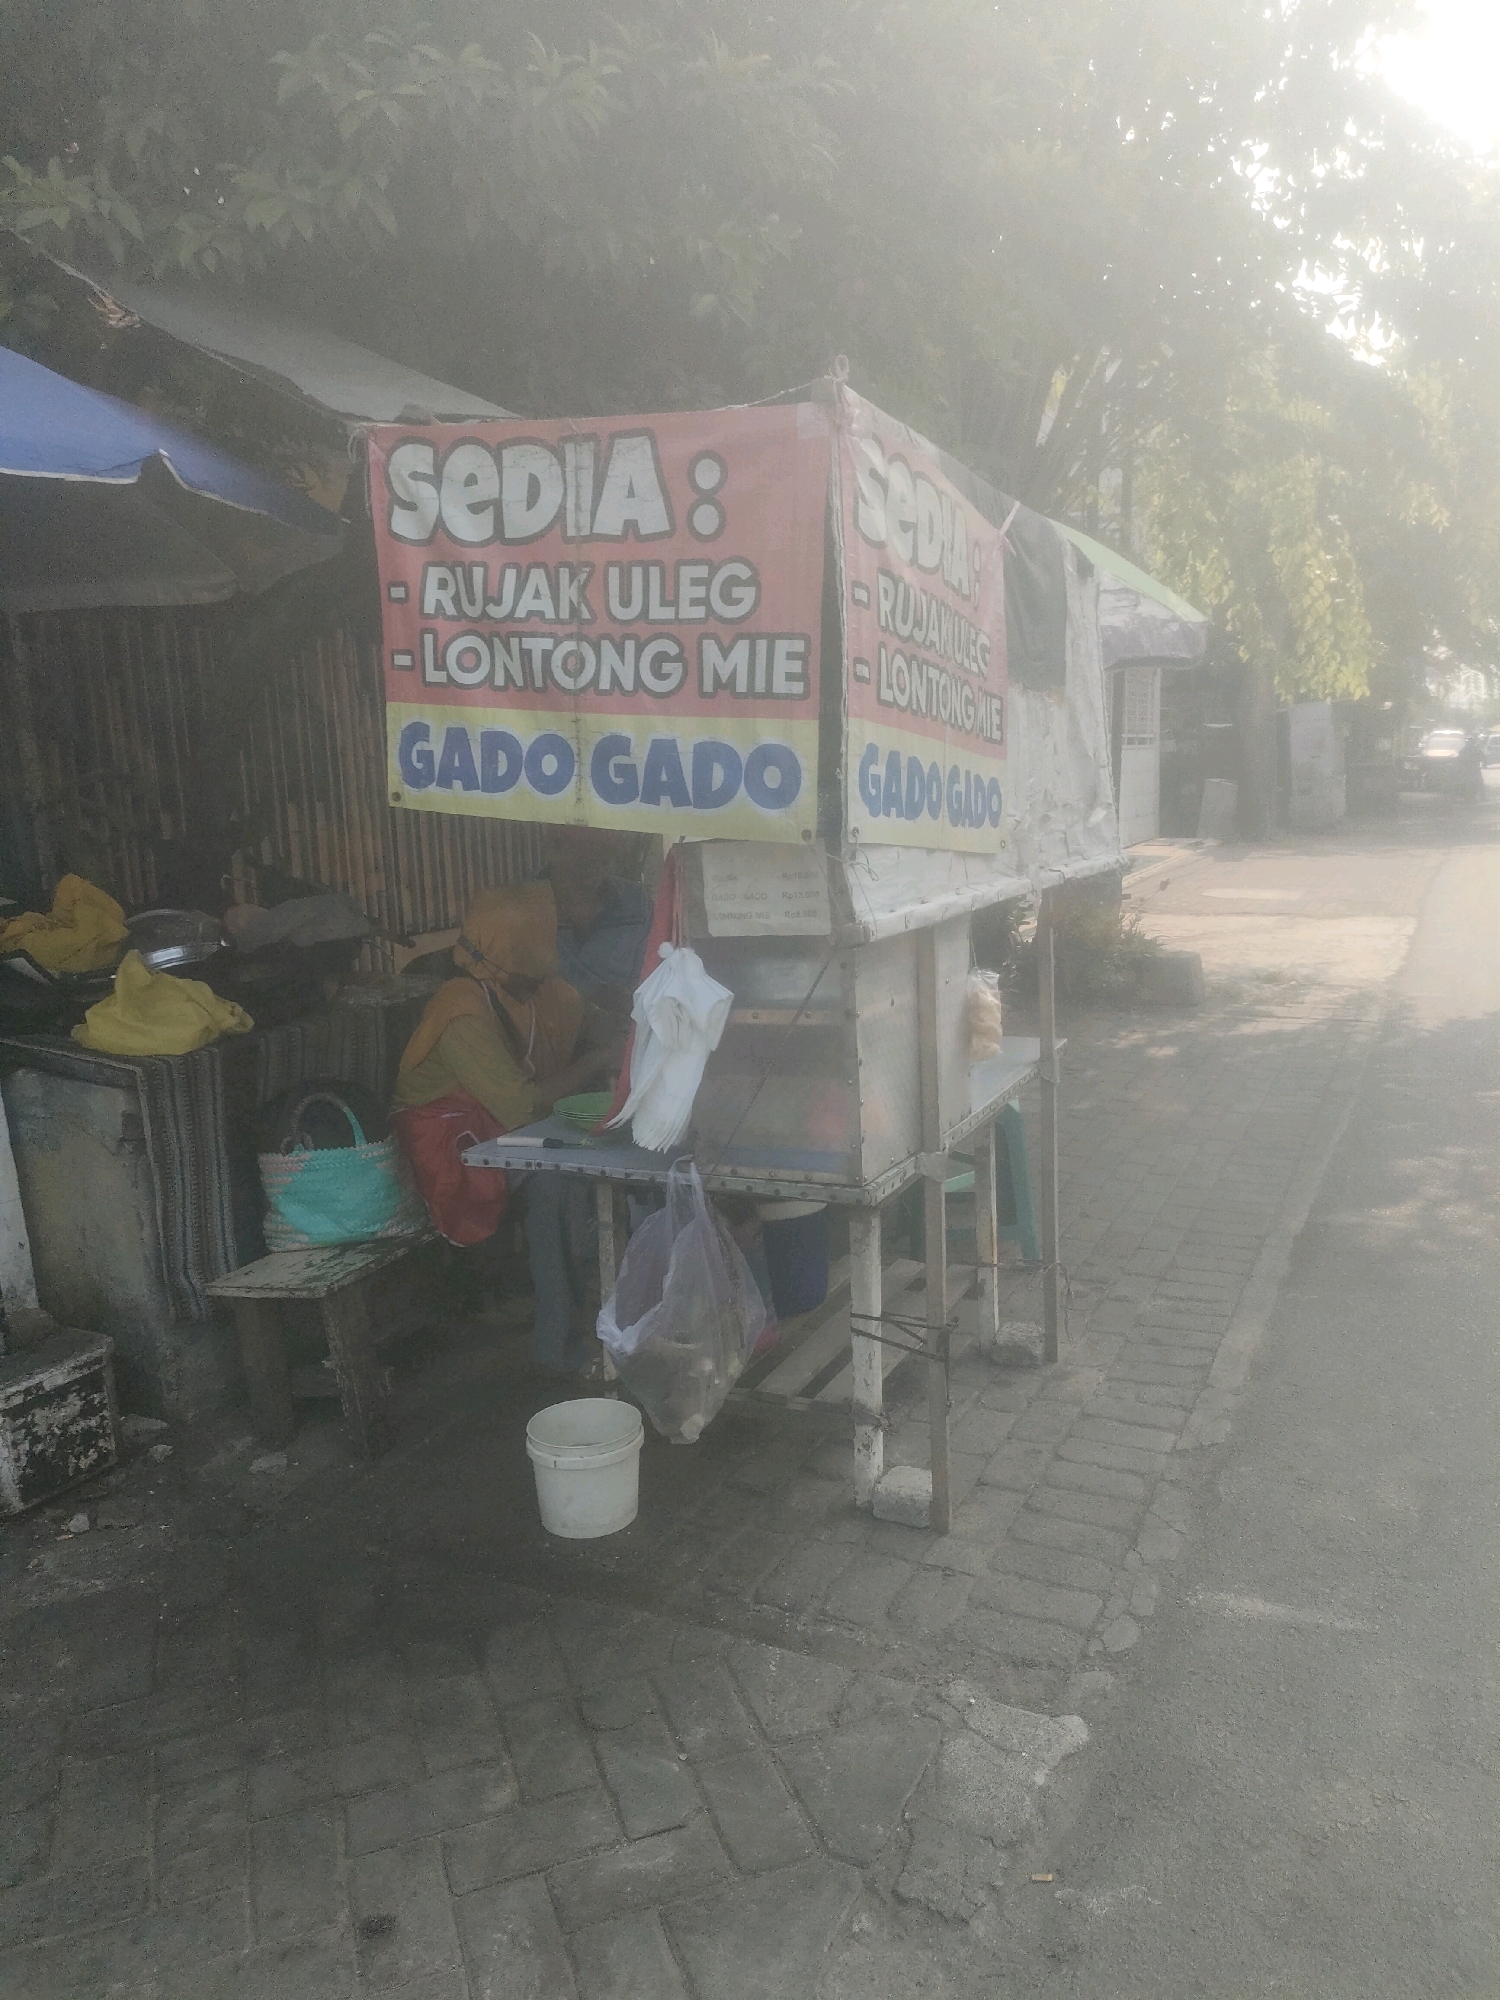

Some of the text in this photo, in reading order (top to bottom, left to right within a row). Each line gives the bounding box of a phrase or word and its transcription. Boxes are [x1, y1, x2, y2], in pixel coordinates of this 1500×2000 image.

[421, 562, 597, 626] RUJAK
[605, 556, 762, 626] ULEG
[421, 631, 687, 694] LONTONG
[699, 634, 810, 699] MIE
[877, 642, 975, 734] LONTONG
[399, 722, 802, 811] GADO GADO
[858, 742, 1001, 829] GADO GADO
